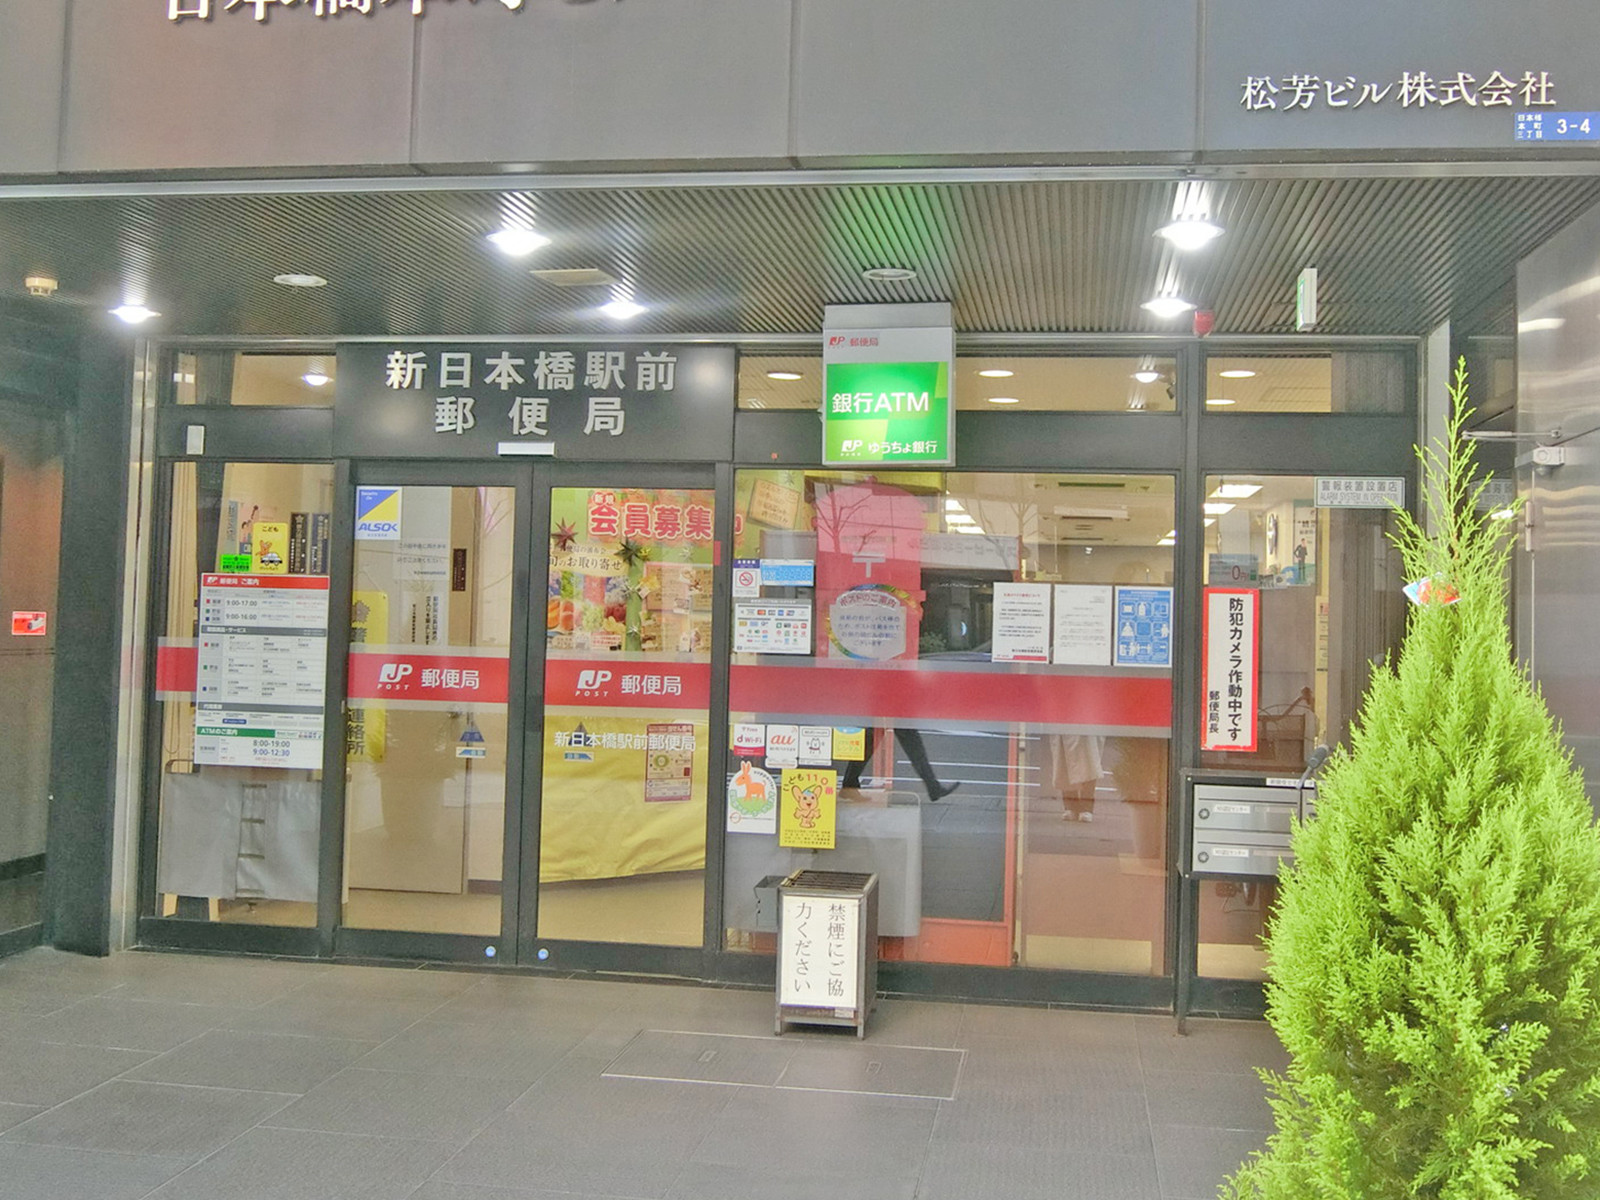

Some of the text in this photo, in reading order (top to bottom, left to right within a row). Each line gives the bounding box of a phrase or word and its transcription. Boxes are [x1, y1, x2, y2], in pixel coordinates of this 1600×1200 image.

[1240, 70, 1557, 111] 松芳ビル株式会社
[1556, 118, 1591, 134] 3-4
[385, 351, 678, 391] 新日本橋駅前
[832, 392, 929, 414] 銀行ATM
[434, 396, 626, 436] 郵便局
[868, 441, 938, 454] ゆうちょ銀行
[1322, 480, 1397, 492] 警報装置設置店
[358, 522, 399, 532] ALSOK
[590, 503, 712, 539] 会員募集
[421, 668, 480, 689] 郵便局
[1228, 597, 1244, 741] 防犯カメラ作動中です
[621, 674, 682, 695] 郵便局
[1209, 690, 1220, 734] 郵便局長
[554, 732, 696, 752] 新日本橋駅前郵便局
[770, 734, 796, 745] au
[253, 749, 290, 757] 9:00-12:30
[794, 902, 813, 993] 力ください
[827, 903, 846, 997] 禁煙にご協
